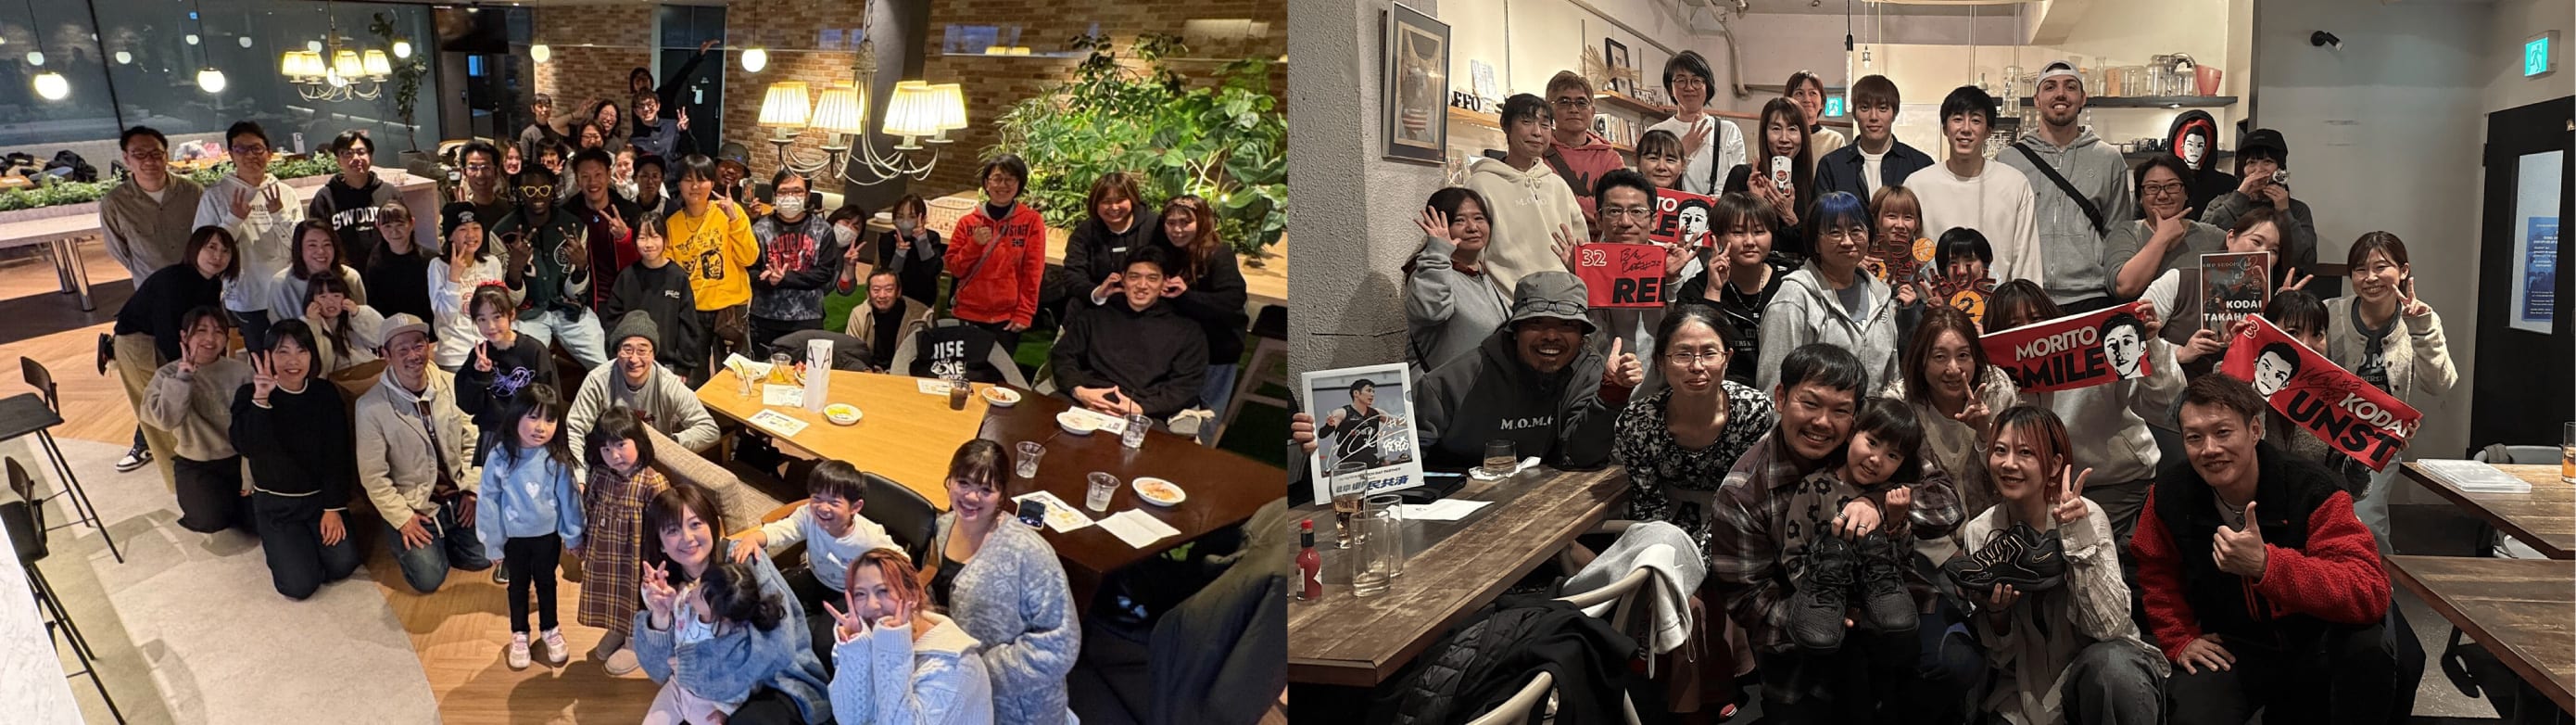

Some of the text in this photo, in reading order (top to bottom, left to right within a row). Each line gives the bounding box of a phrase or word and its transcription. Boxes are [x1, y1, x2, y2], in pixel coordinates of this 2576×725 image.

[1582, 248, 1607, 267] 32
[1958, 298, 1975, 317] 2
[2226, 299, 2262, 309] KODAI
[2203, 312, 2265, 322] TAKAHA
[2242, 319, 2260, 338] 3
[2015, 325, 2098, 362] MORITO
[807, 346, 816, 368] A
[821, 348, 830, 369] A
[2339, 392, 2407, 438] KODA
[2287, 389, 2402, 463] UNST
